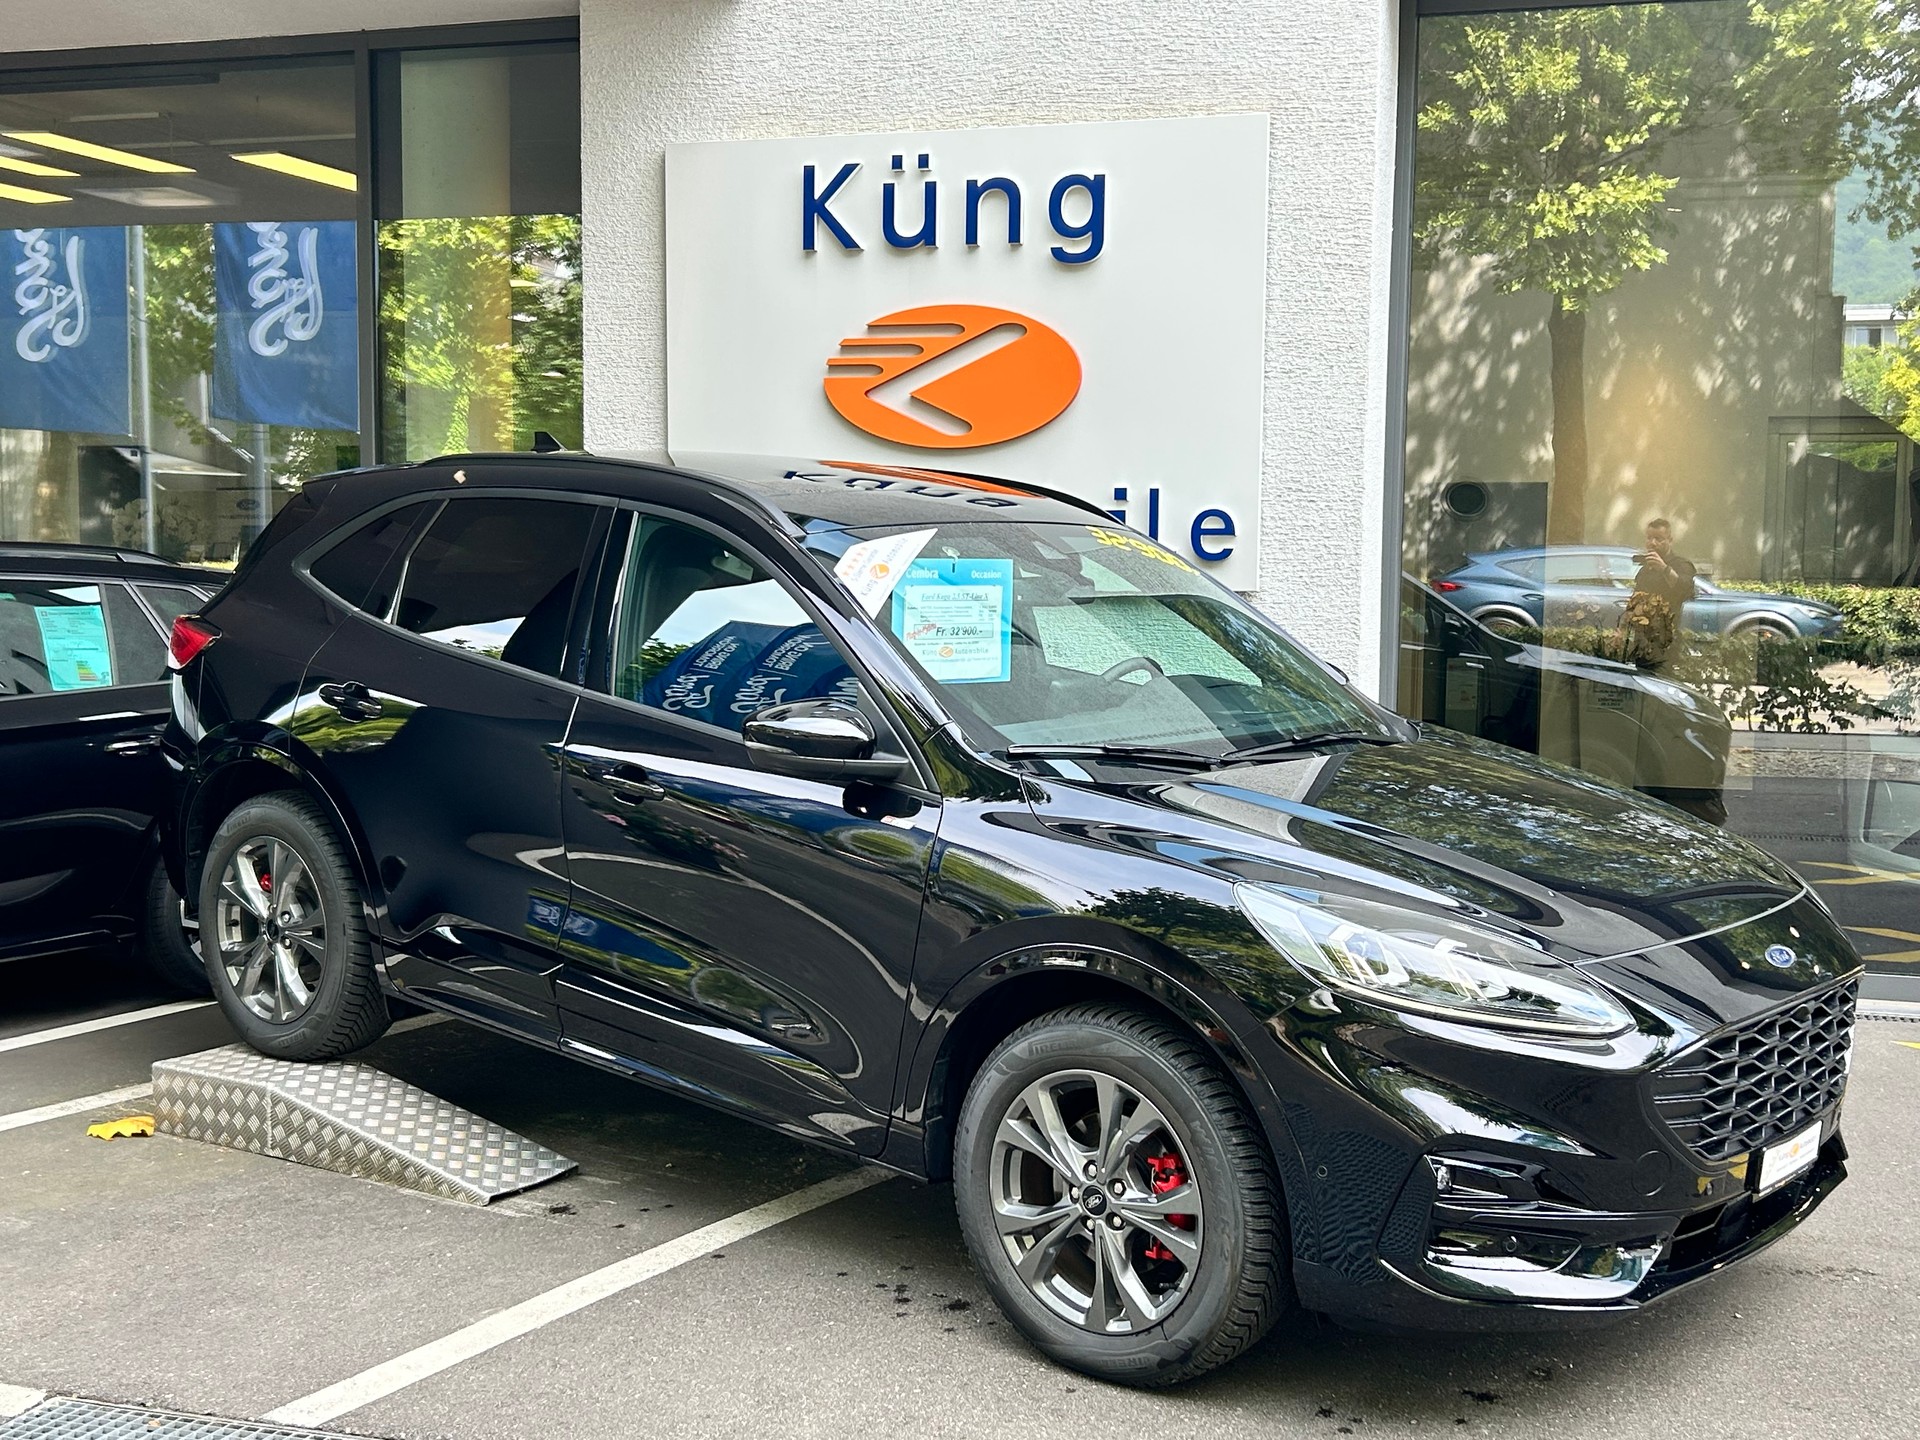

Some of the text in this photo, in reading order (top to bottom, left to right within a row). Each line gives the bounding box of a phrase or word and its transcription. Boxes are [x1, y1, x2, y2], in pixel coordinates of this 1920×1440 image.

[802, 153, 1107, 264] Küng
[971, 569, 1002, 579] Occasion
[936, 626, 947, 636] Fr.
[950, 626, 983, 636] 32'900.-
